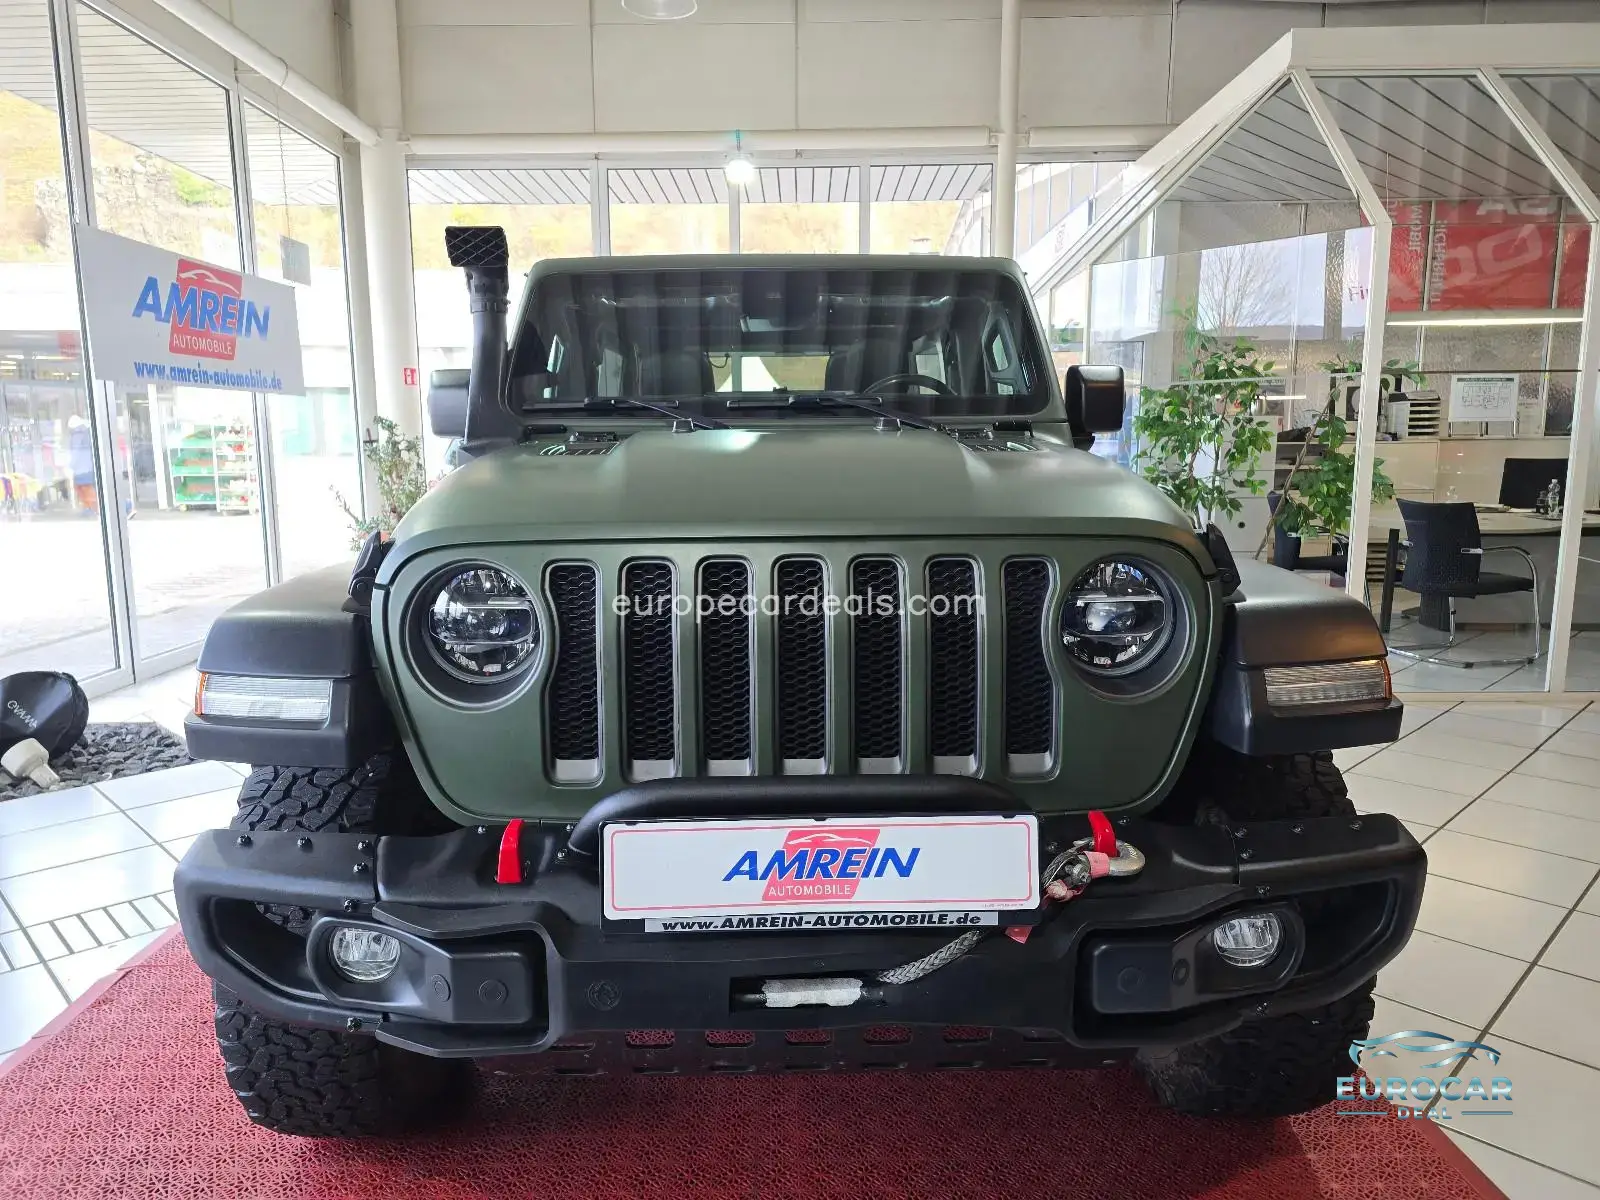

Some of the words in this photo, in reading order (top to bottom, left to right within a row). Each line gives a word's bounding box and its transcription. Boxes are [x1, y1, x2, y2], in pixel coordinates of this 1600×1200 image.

[132, 276, 270, 341] AMREIN
[173, 333, 233, 355] AUTOMOBILE
[134, 360, 283, 390] www.amrein-automobile.de
[721, 847, 921, 882] AMREIN
[768, 884, 852, 897] AUTOMOBILE
[661, 913, 982, 931] www.AMREIN-AUTOMOBILE.de
